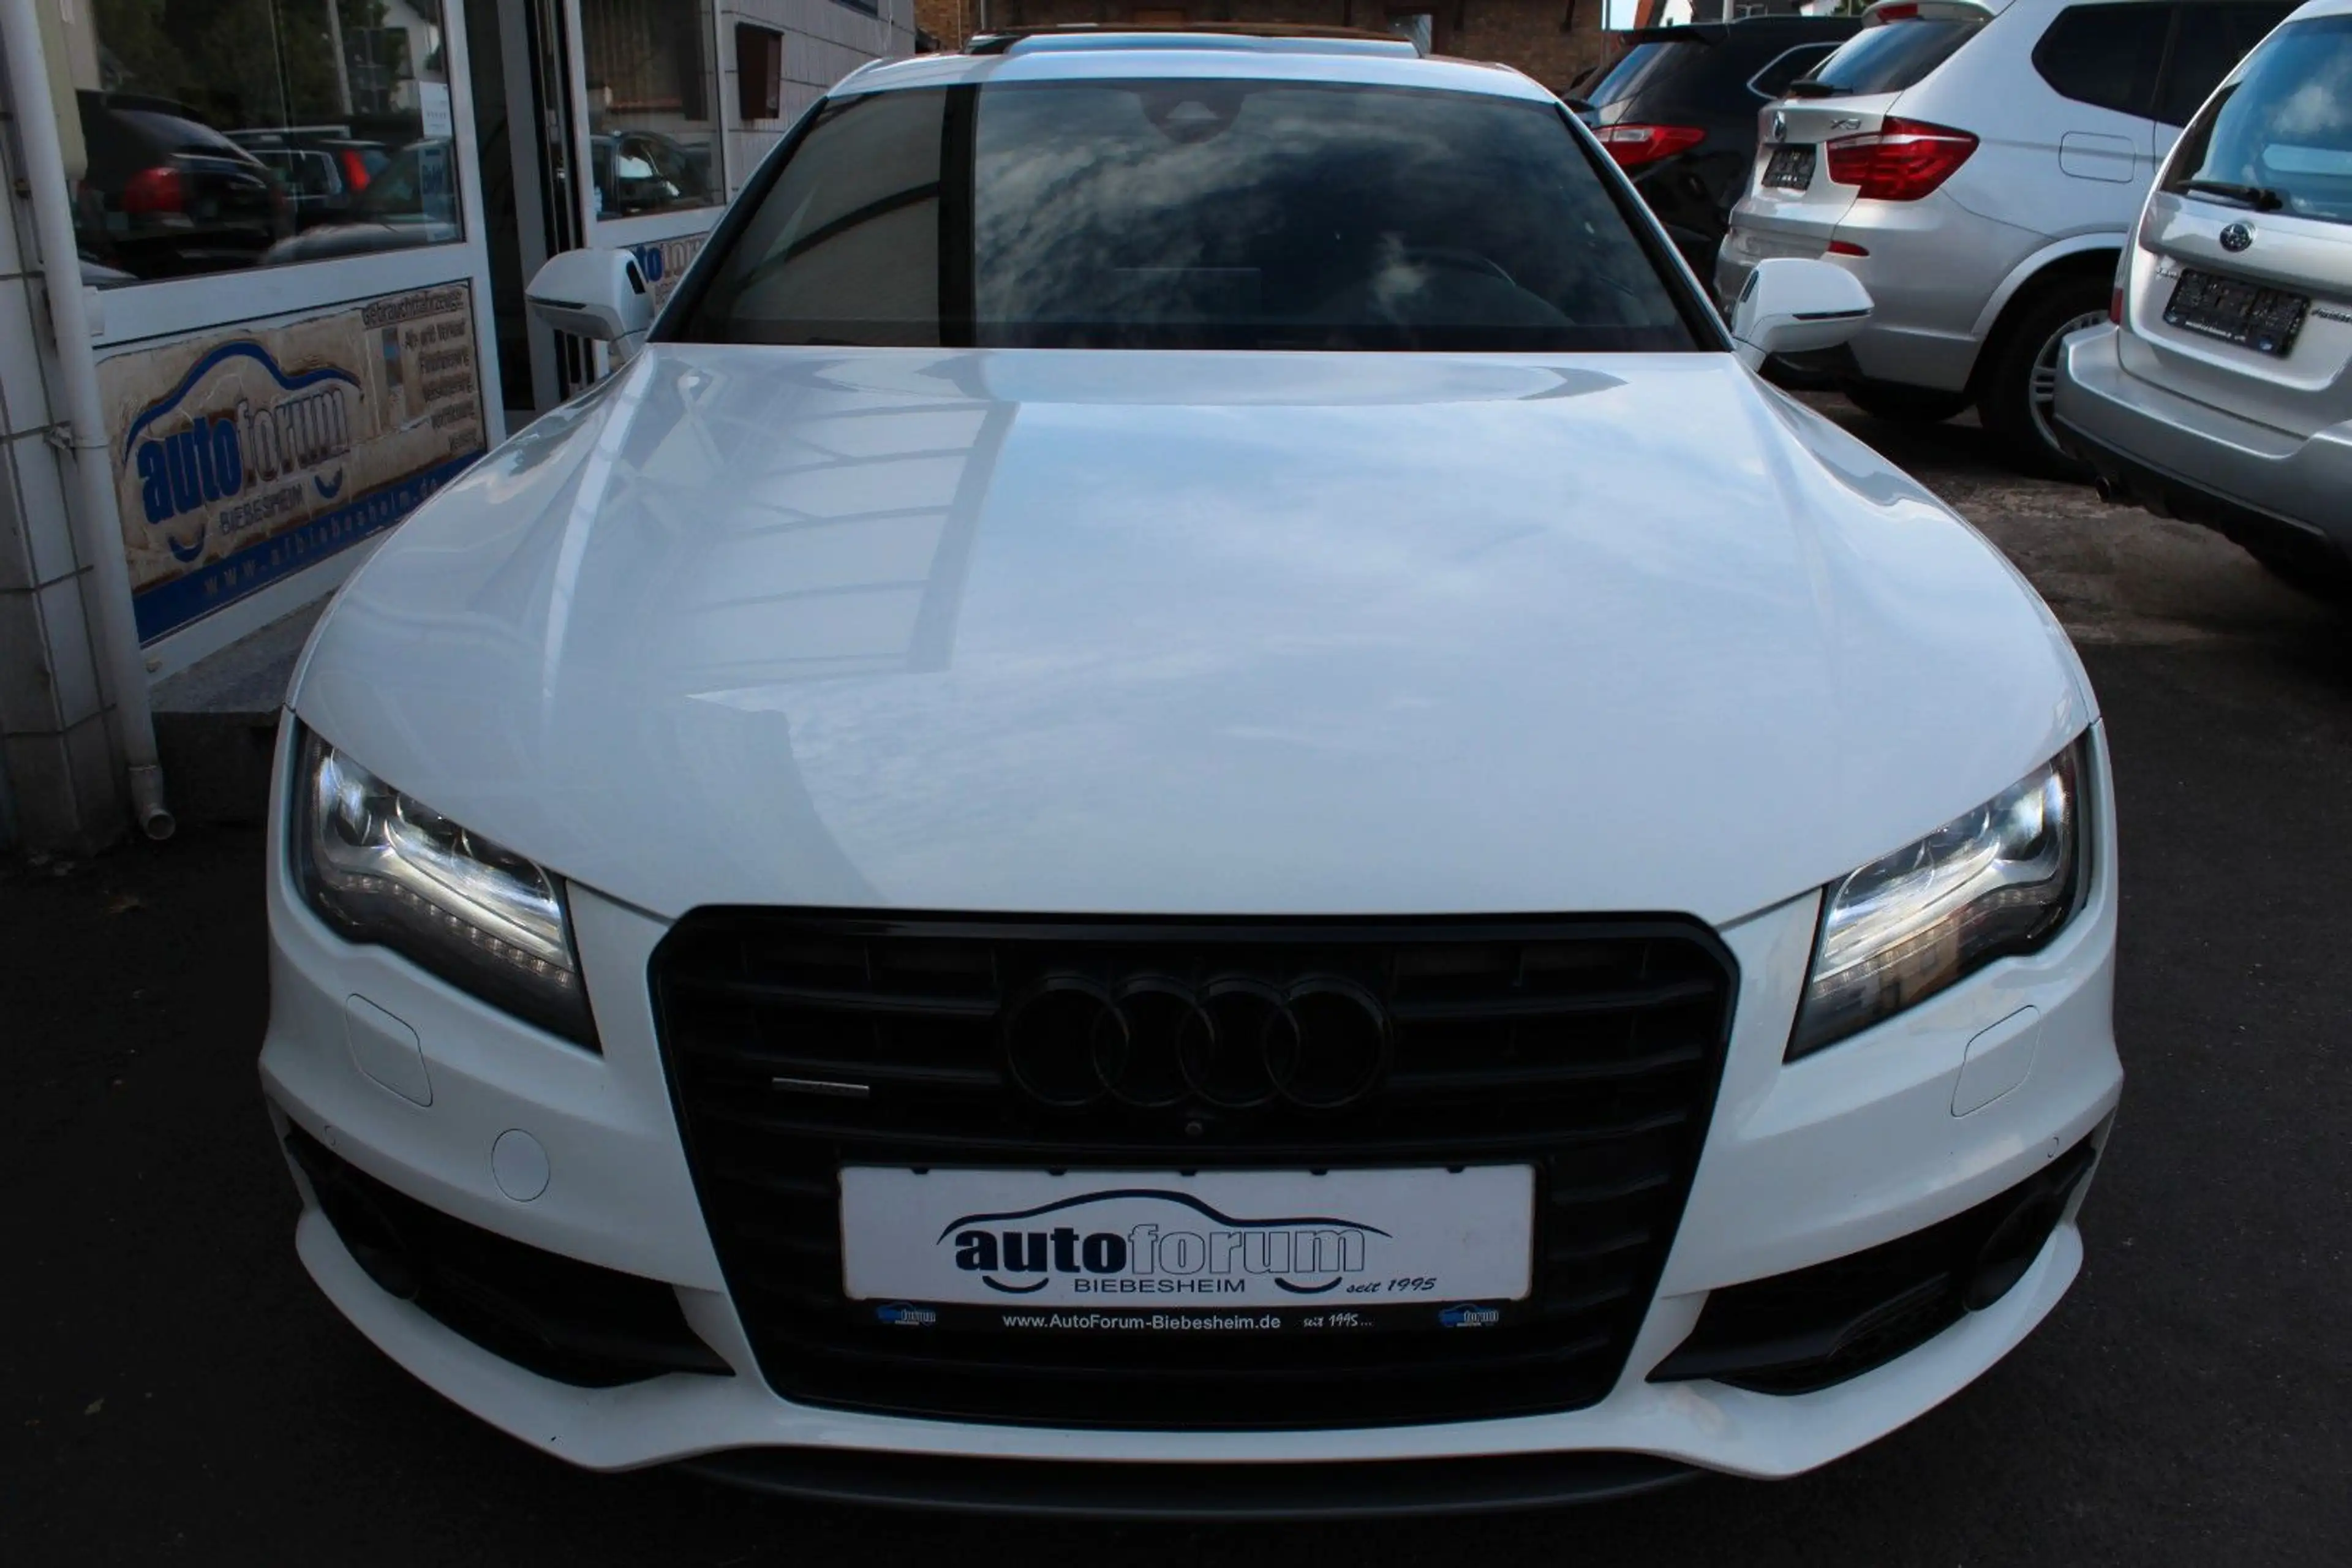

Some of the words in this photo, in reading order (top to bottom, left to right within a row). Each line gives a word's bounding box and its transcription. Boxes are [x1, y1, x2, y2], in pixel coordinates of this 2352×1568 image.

[219, 483, 304, 535] BIEBESHEIM
[955, 1223, 1365, 1275] autoforum
[1073, 1278, 1246, 1293] BIEBESHEIM
[1346, 1281, 1382, 1294] seit
[1387, 1277, 1437, 1292] 1995
[1002, 1313, 1281, 1330] www.AutoForum-Biebesheim.de
[1303, 1315, 1324, 1328] seit
